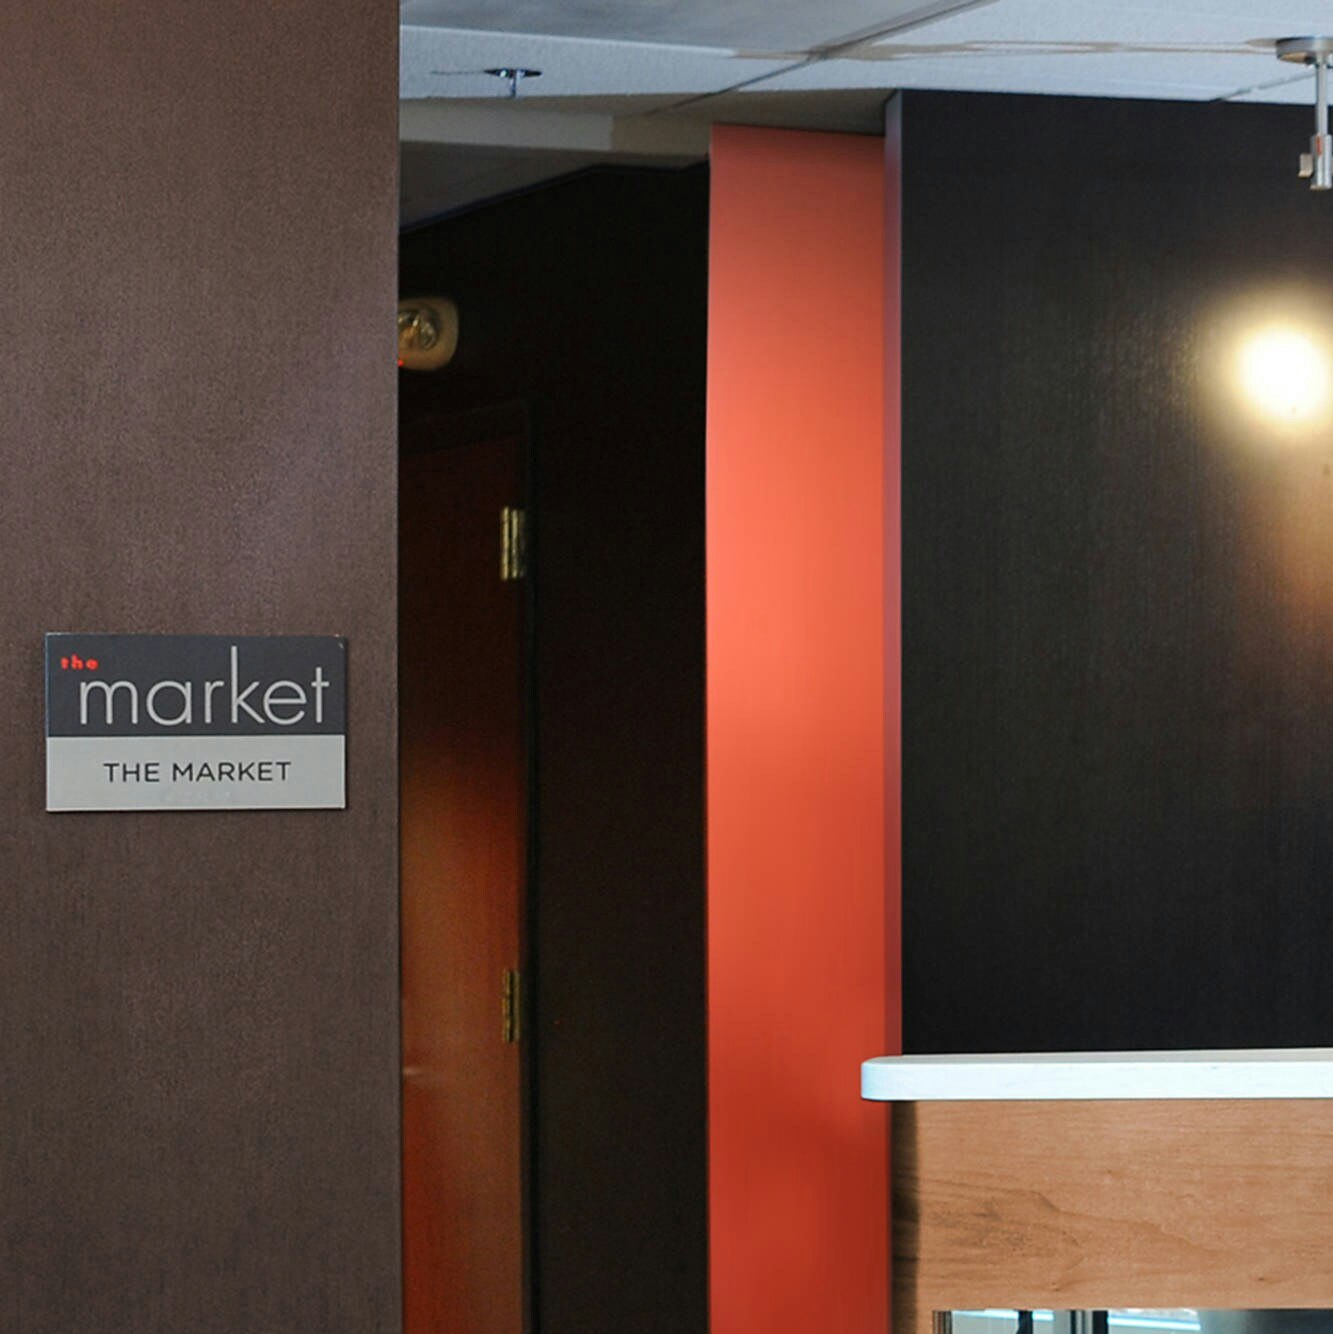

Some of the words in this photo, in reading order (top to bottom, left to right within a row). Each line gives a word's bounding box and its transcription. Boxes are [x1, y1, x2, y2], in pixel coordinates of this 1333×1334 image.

[60, 654, 99, 670] the
[80, 645, 330, 726] market
[103, 762, 160, 783] THE
[172, 761, 292, 782] MARKET
